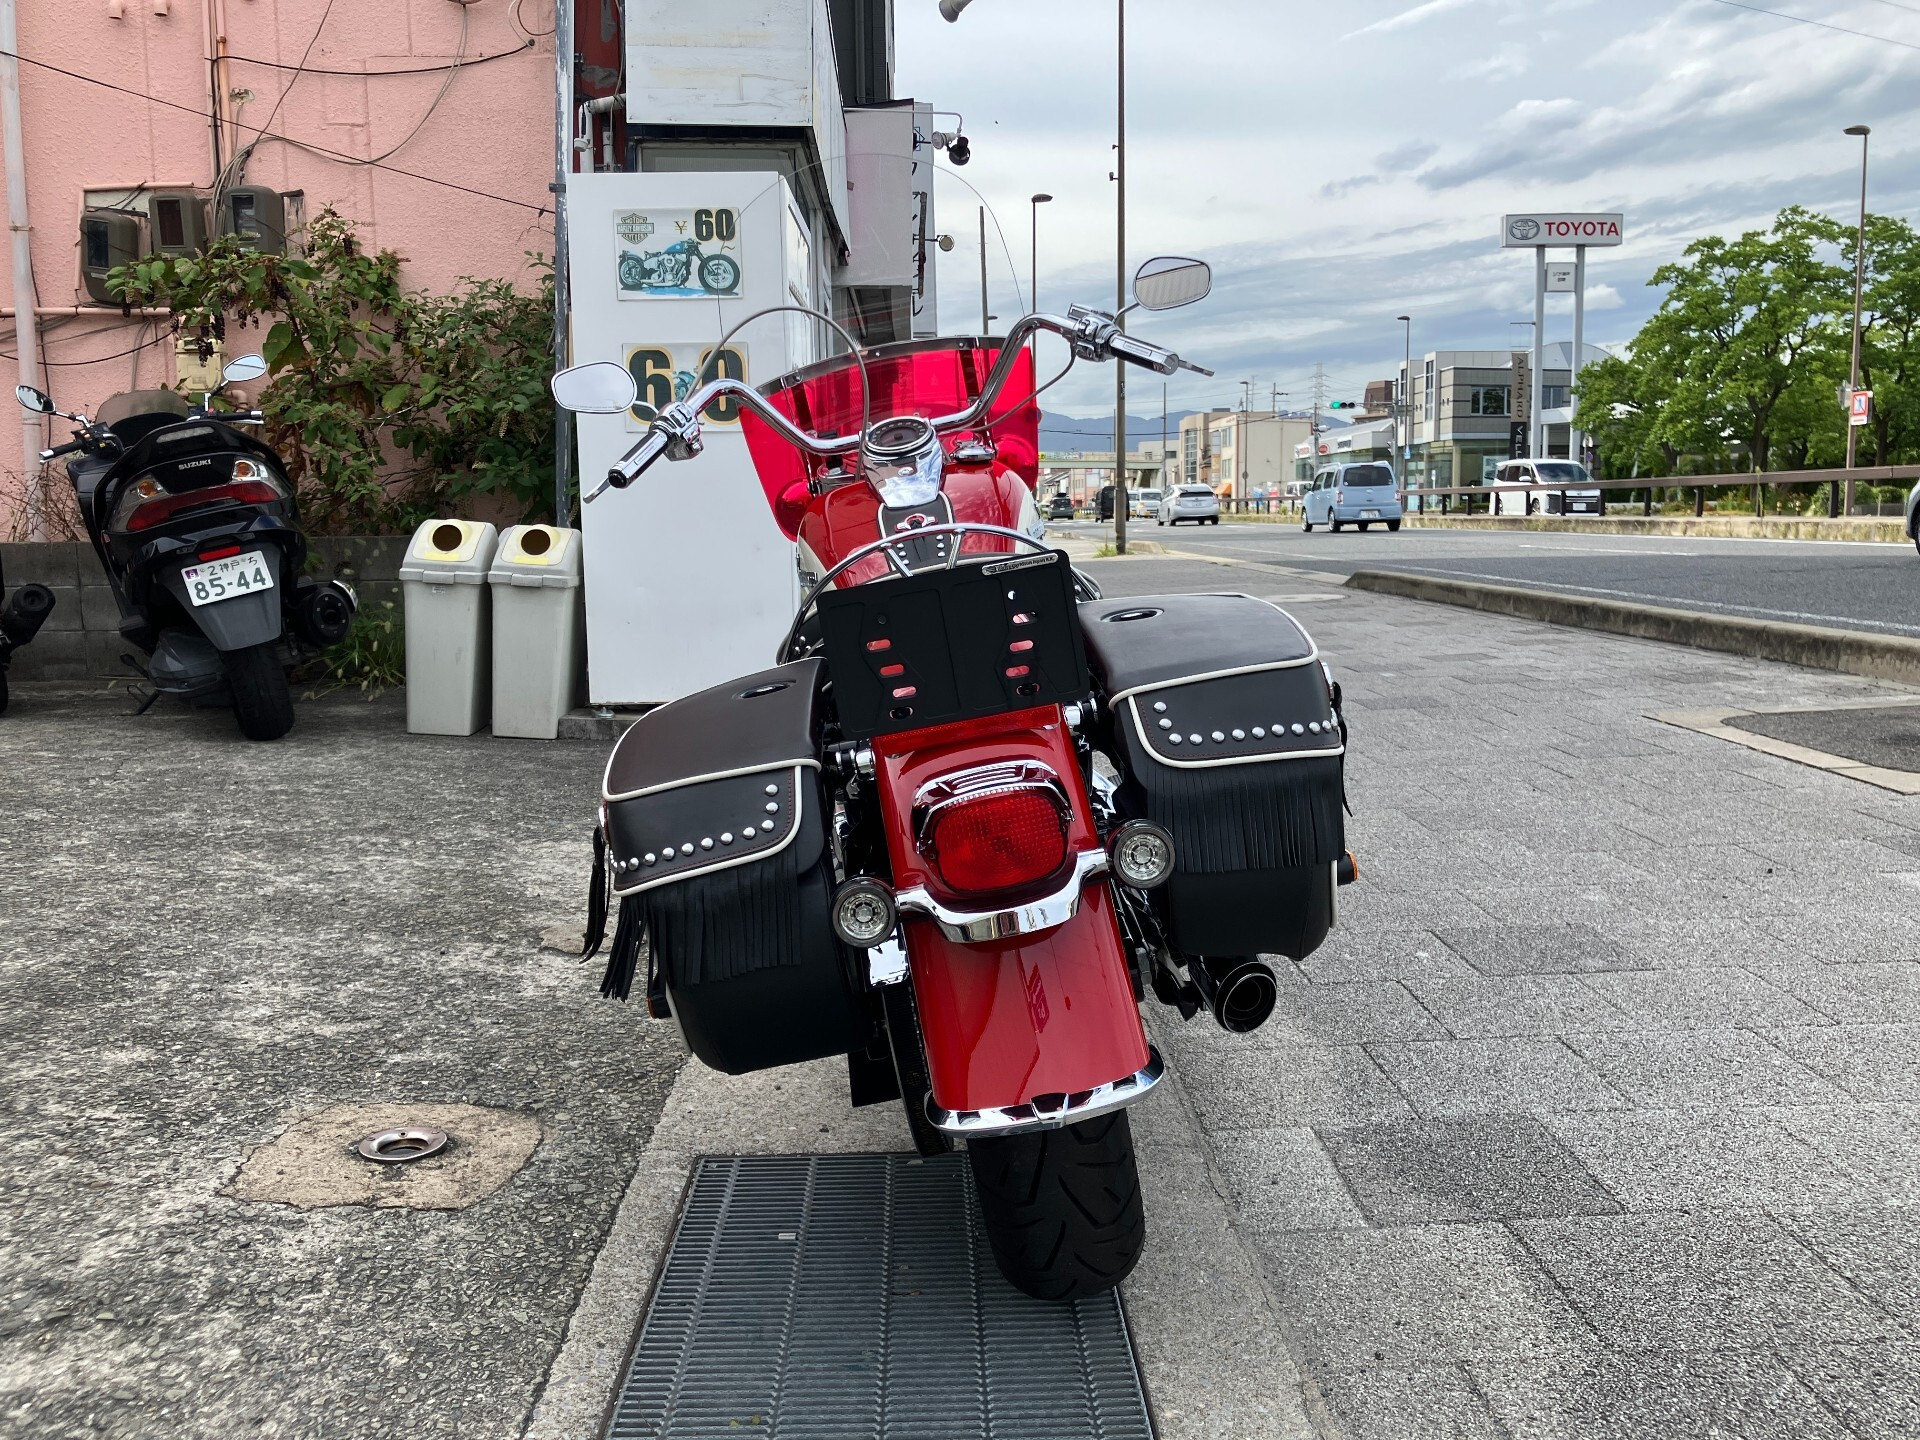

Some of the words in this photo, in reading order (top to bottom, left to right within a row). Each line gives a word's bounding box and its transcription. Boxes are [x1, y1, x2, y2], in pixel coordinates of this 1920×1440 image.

[693, 208, 737, 242] 60
[1544, 221, 1619, 236] TOYOTA
[1517, 357, 1525, 418] ALPHARD
[178, 458, 211, 470] SUZUKI
[194, 567, 266, 600] 85-44
